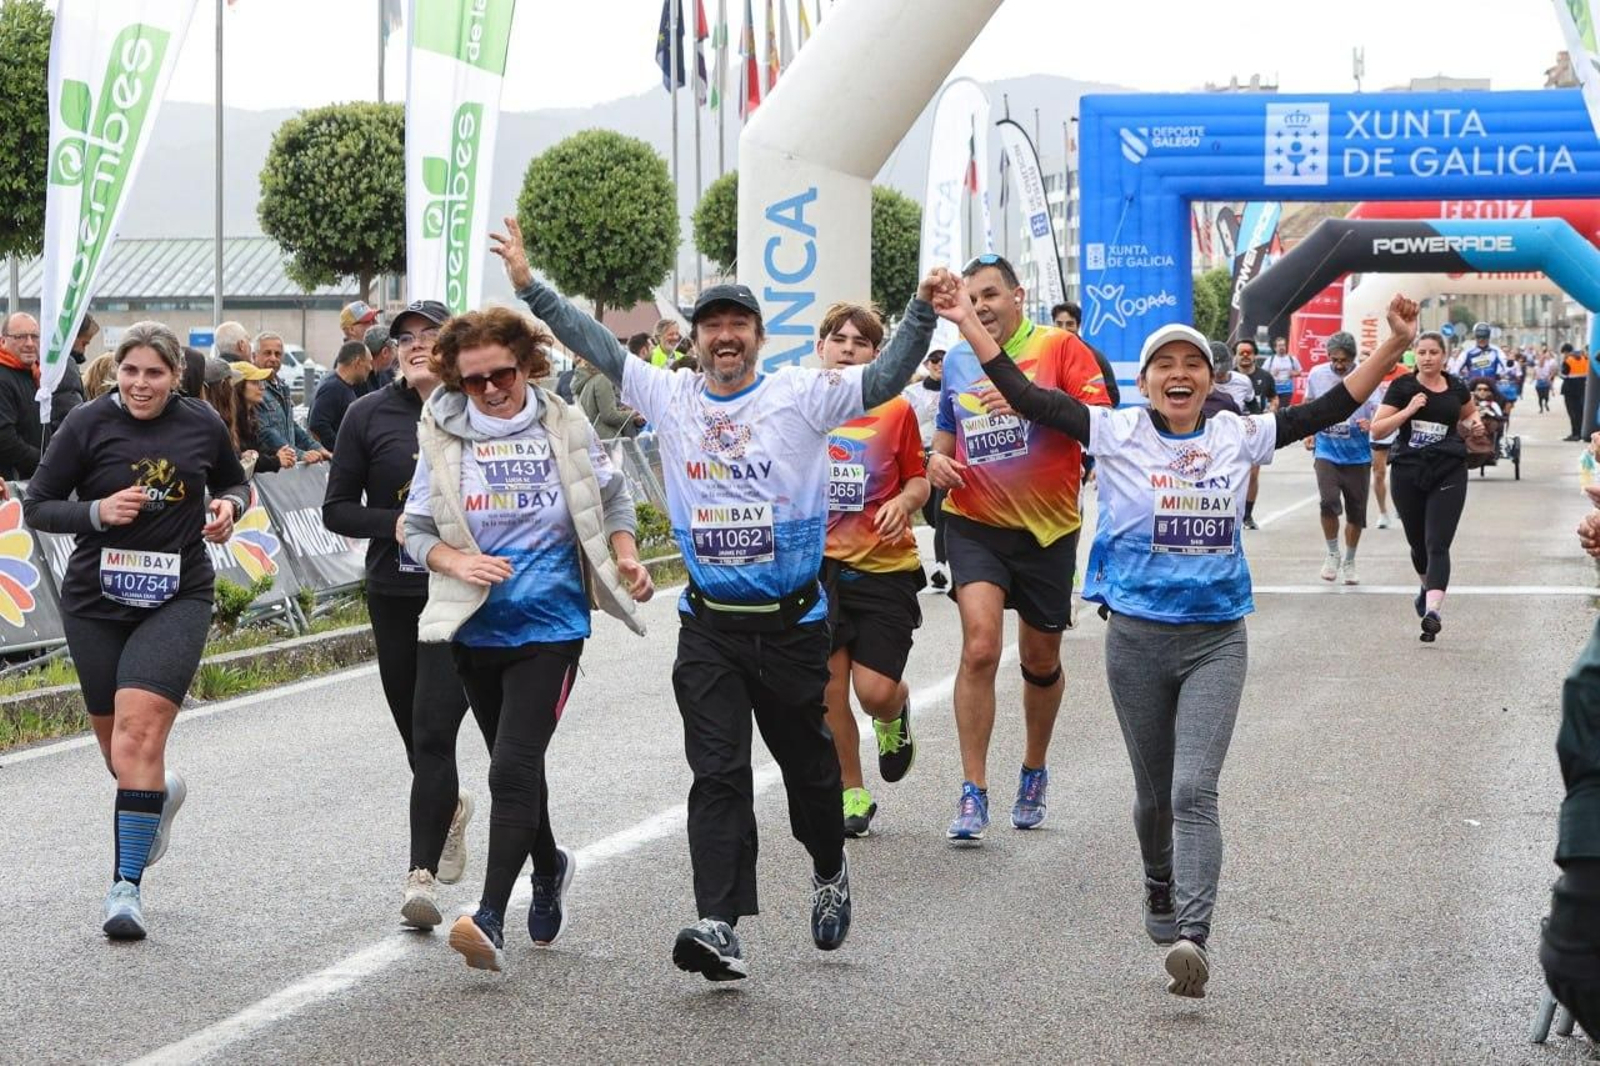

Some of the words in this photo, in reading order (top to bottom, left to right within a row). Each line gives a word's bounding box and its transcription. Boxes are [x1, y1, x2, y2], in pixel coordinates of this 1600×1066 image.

[466, 24, 481, 61] de
[1152, 127, 1204, 137] DEPORTE
[1345, 109, 1487, 140] XUNTA
[1152, 137, 1200, 147] GALEGO
[1343, 148, 1395, 177] DE
[1410, 145, 1577, 177] GALICIA
[1109, 246, 1148, 255] XUNTA
[1373, 235, 1513, 254] POWERADE
[1108, 257, 1123, 267] DE
[1127, 255, 1174, 266] GALICIA
[975, 430, 1016, 450] 11066
[477, 444, 547, 457] MINIBAY
[488, 461, 545, 476] 11431
[687, 461, 772, 480] MINIBAY
[830, 483, 856, 497] 065
[466, 491, 558, 511] MINIBAY
[1161, 496, 1231, 511] MINIBAY
[698, 507, 764, 522] MINIBAY
[1170, 518, 1225, 537] 11061
[705, 528, 763, 547] 11062
[107, 553, 174, 569] MINIBAY
[115, 574, 169, 592] 10754
